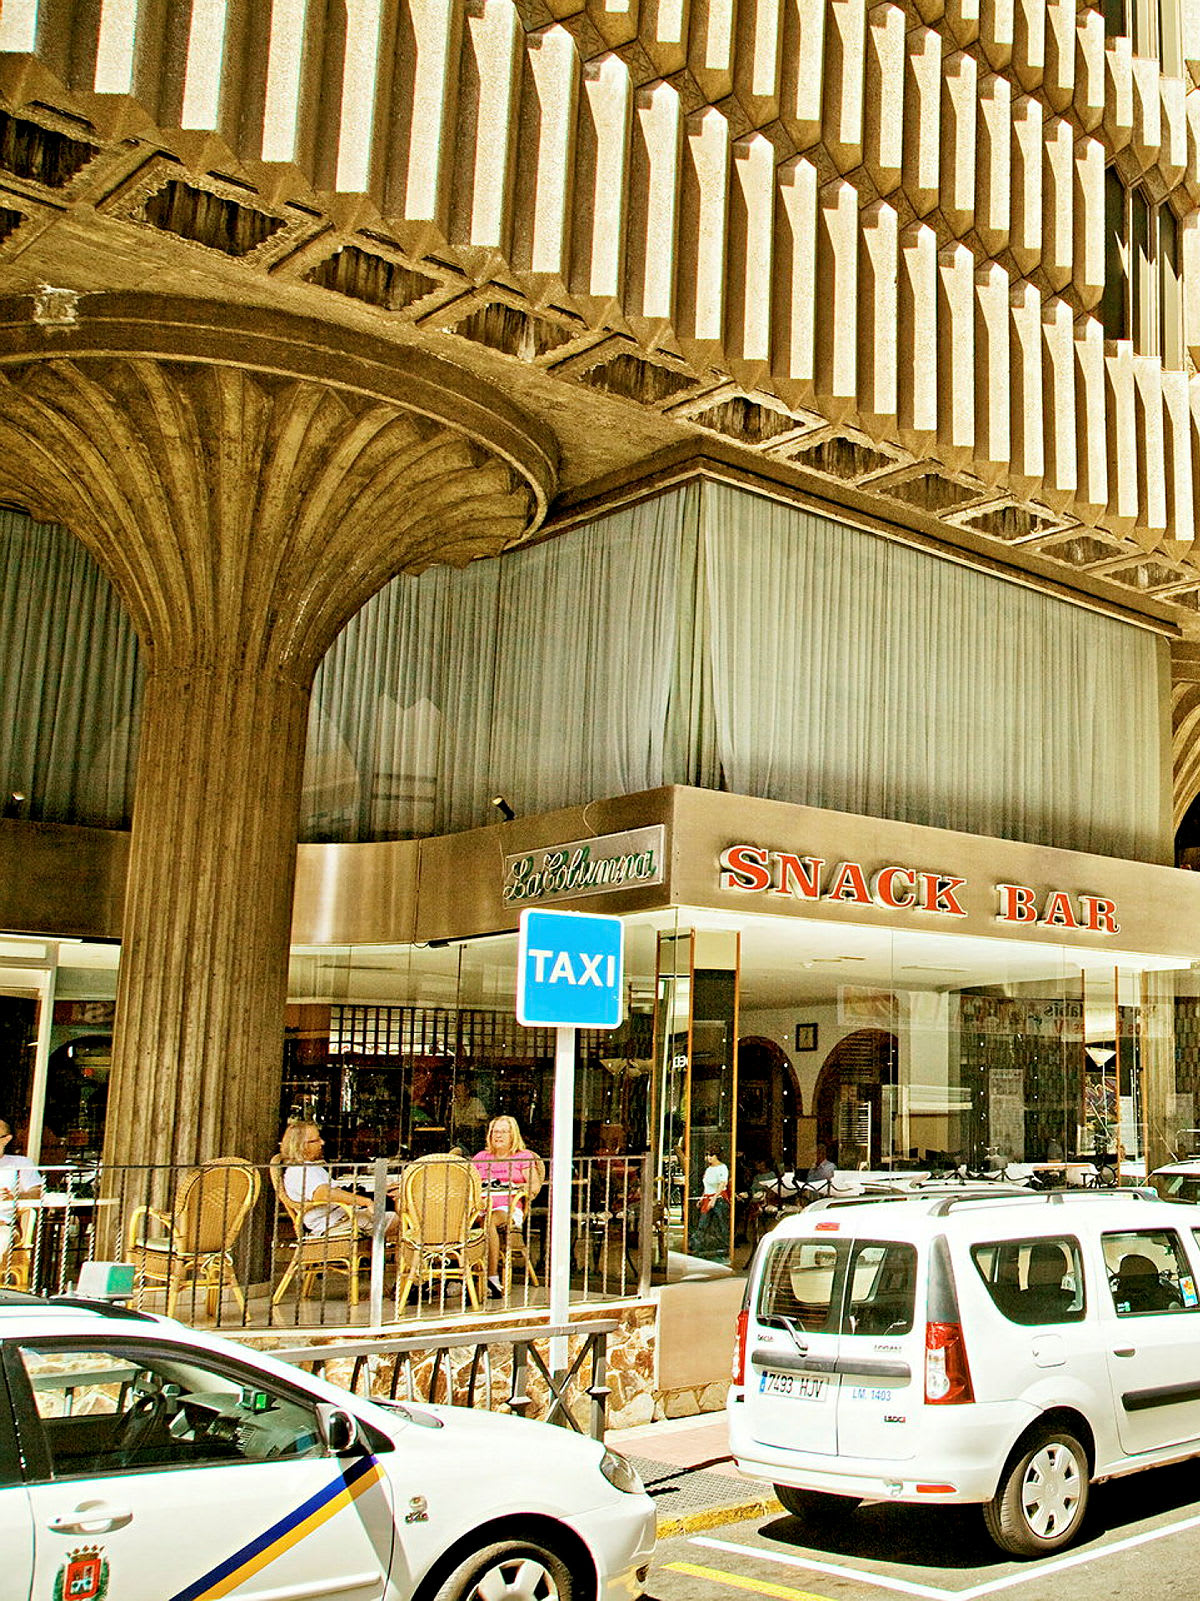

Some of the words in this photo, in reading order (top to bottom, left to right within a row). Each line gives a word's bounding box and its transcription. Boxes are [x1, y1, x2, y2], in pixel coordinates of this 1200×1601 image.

[720, 845, 968, 917] SNACK
[996, 884, 1120, 935] BAR
[528, 949, 616, 988] TAXI
[768, 1374, 794, 1395] 7493
[800, 1378, 824, 1398] HJV
[871, 1390, 892, 1402] 1403
